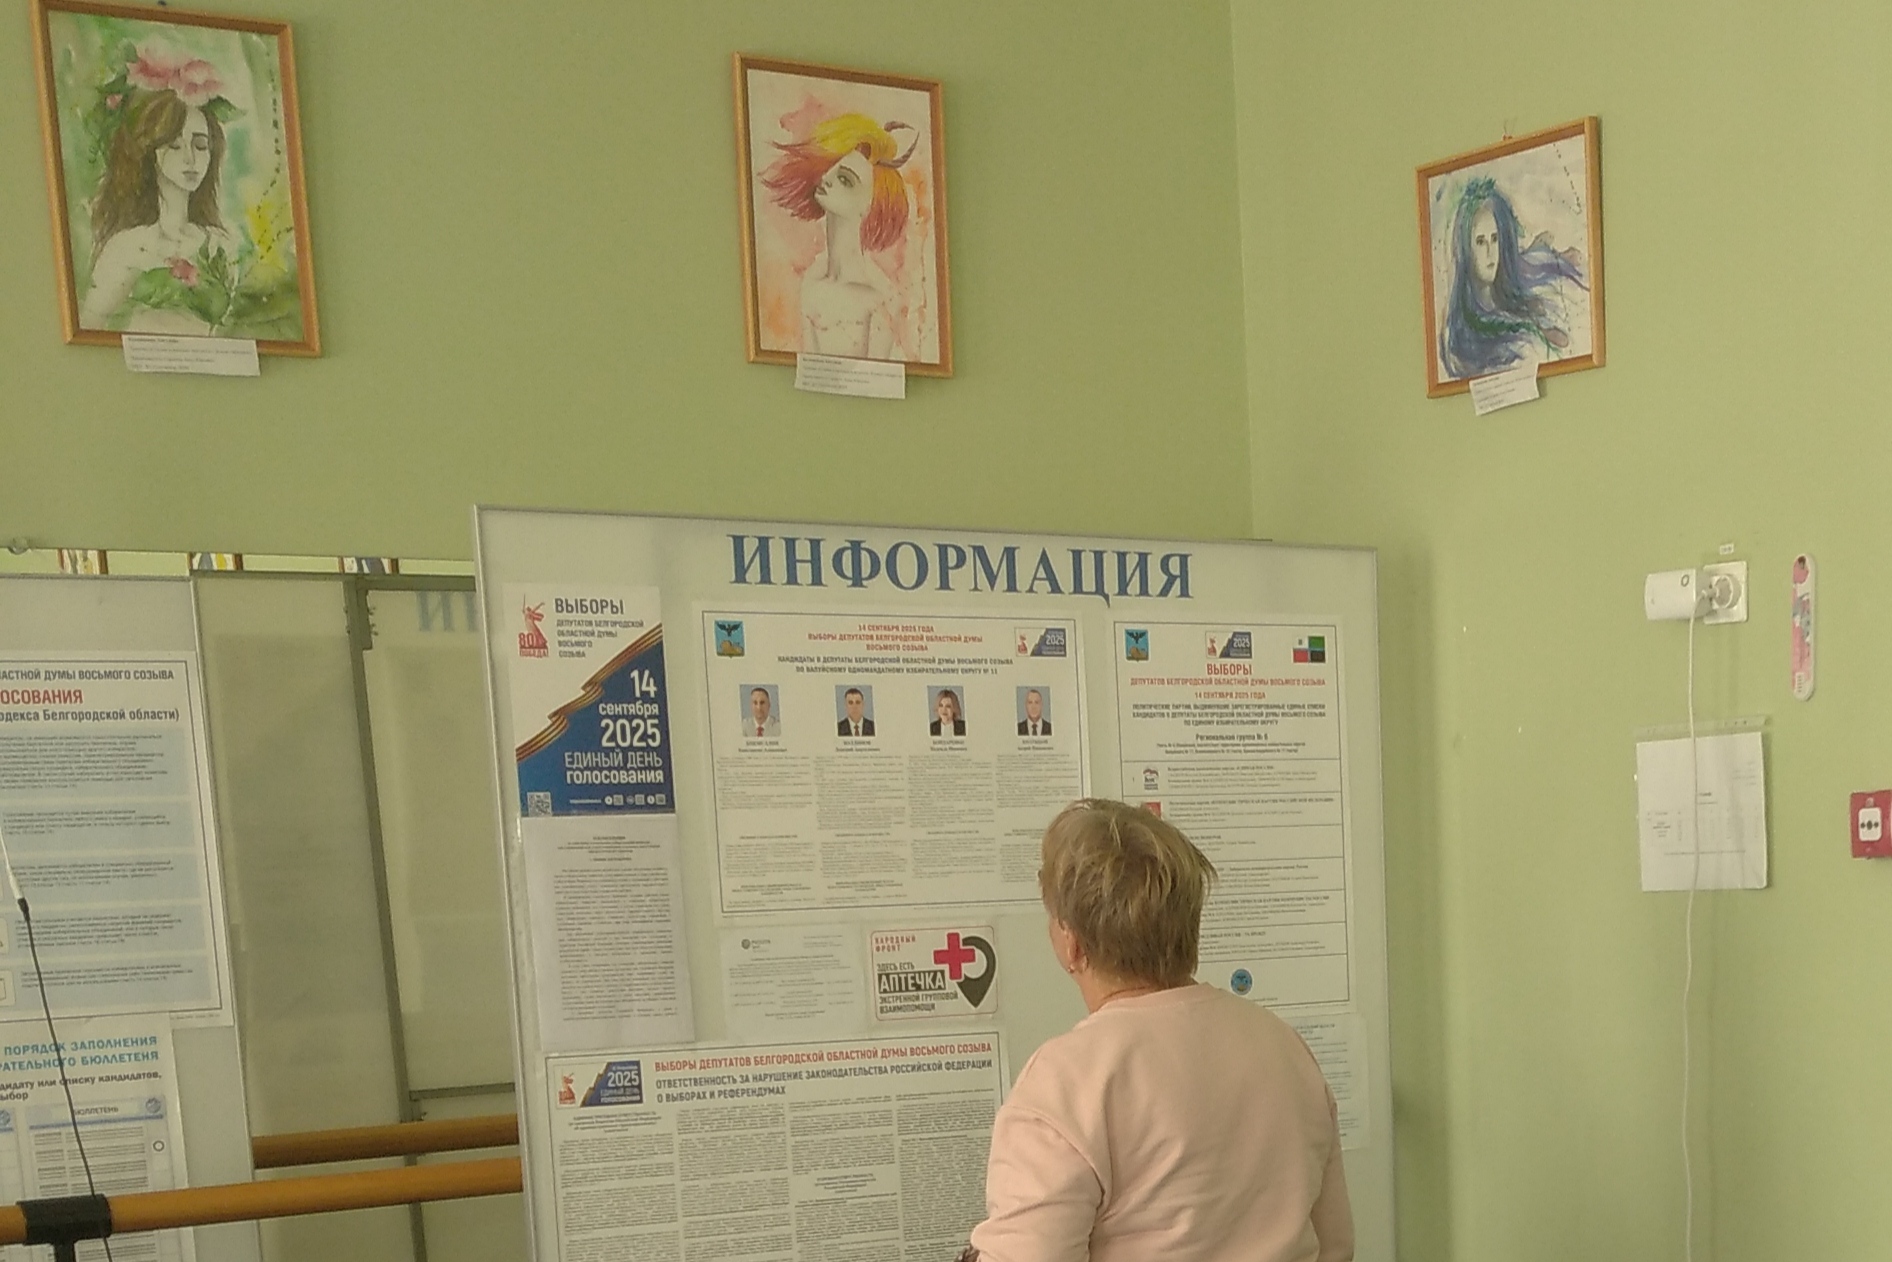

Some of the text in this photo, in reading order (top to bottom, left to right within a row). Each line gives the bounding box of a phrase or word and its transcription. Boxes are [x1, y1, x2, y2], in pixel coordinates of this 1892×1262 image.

[726, 534, 1194, 608] ИНФОРМАЦИЯ
[555, 598, 624, 615] ВЫБОРЫ
[556, 619, 644, 628] ДЕПУТАТОВ БЕЛГОРОДСКОЙ
[867, 624, 900, 632] СЕНТЯБРЯ
[519, 632, 534, 648] 80
[557, 629, 618, 638] ОБЛАСТНОЙ ДУМЫ
[808, 633, 837, 641] ВЫБОРЫ
[838, 634, 874, 642] ДЕПУТАТОВ
[963, 636, 982, 644] ДУМЫ
[1045, 634, 1065, 646] 2025
[866, 644, 901, 652] ВОСЬМОГО
[0, 668, 174, 682] АСТНОЙ ДУМЫ ВОСЬМОГО СОЗЫВА
[1206, 663, 1252, 675] ВЫБОРЫ
[630, 669, 657, 698] 14
[0, 689, 84, 704] ОСОВАНИЯ
[43, 709, 125, 722] Белгородской
[129, 708, 180, 722] области)
[599, 700, 659, 717] сентября
[600, 719, 661, 747] 2025
[565, 749, 663, 769] ЕДИНЫЙ ДЕНЬ
[566, 770, 664, 784] голосования
[875, 935, 916, 945] НАРОДНЫЙ
[876, 944, 900, 952] ФРОНТ
[877, 962, 915, 972] ЗДЕСЬ ЕСТЬ
[880, 971, 945, 993] АПТЕЧКА
[879, 990, 958, 1004] ЭКСТРЕННОЙ ГРУППОВОЙ
[5, 1036, 157, 1056] ПОРЯДОК ЗАПОЛНЕНИЯ
[0, 1051, 159, 1071] АТЕЛЬНОО БЮЛЛЕТЕНЯ
[655, 1042, 992, 1072] ВЫБОРЫ ДЕПУТАТОВ БЕЛГОРОДСКОЙ ОБЛАСТНОЙ ДУМЫ ВОСЬМОГО СОЗЫВА
[37, 1079, 56, 1087] или
[98, 1071, 162, 1083] кандидатов,
[607, 1070, 640, 1087] 2025
[656, 1058, 992, 1090] ОТВЕТСТВЕННОСТЬ ЗА НАРУШЕНИЕ ЗАКОНОДАТЕЛЬСТВА РОССИЙСКОЙ ФЕДЕРАЦИИ
[657, 1085, 786, 1103] О ВЫБОРАХ И РЕФЕРЕНДУМАХ
